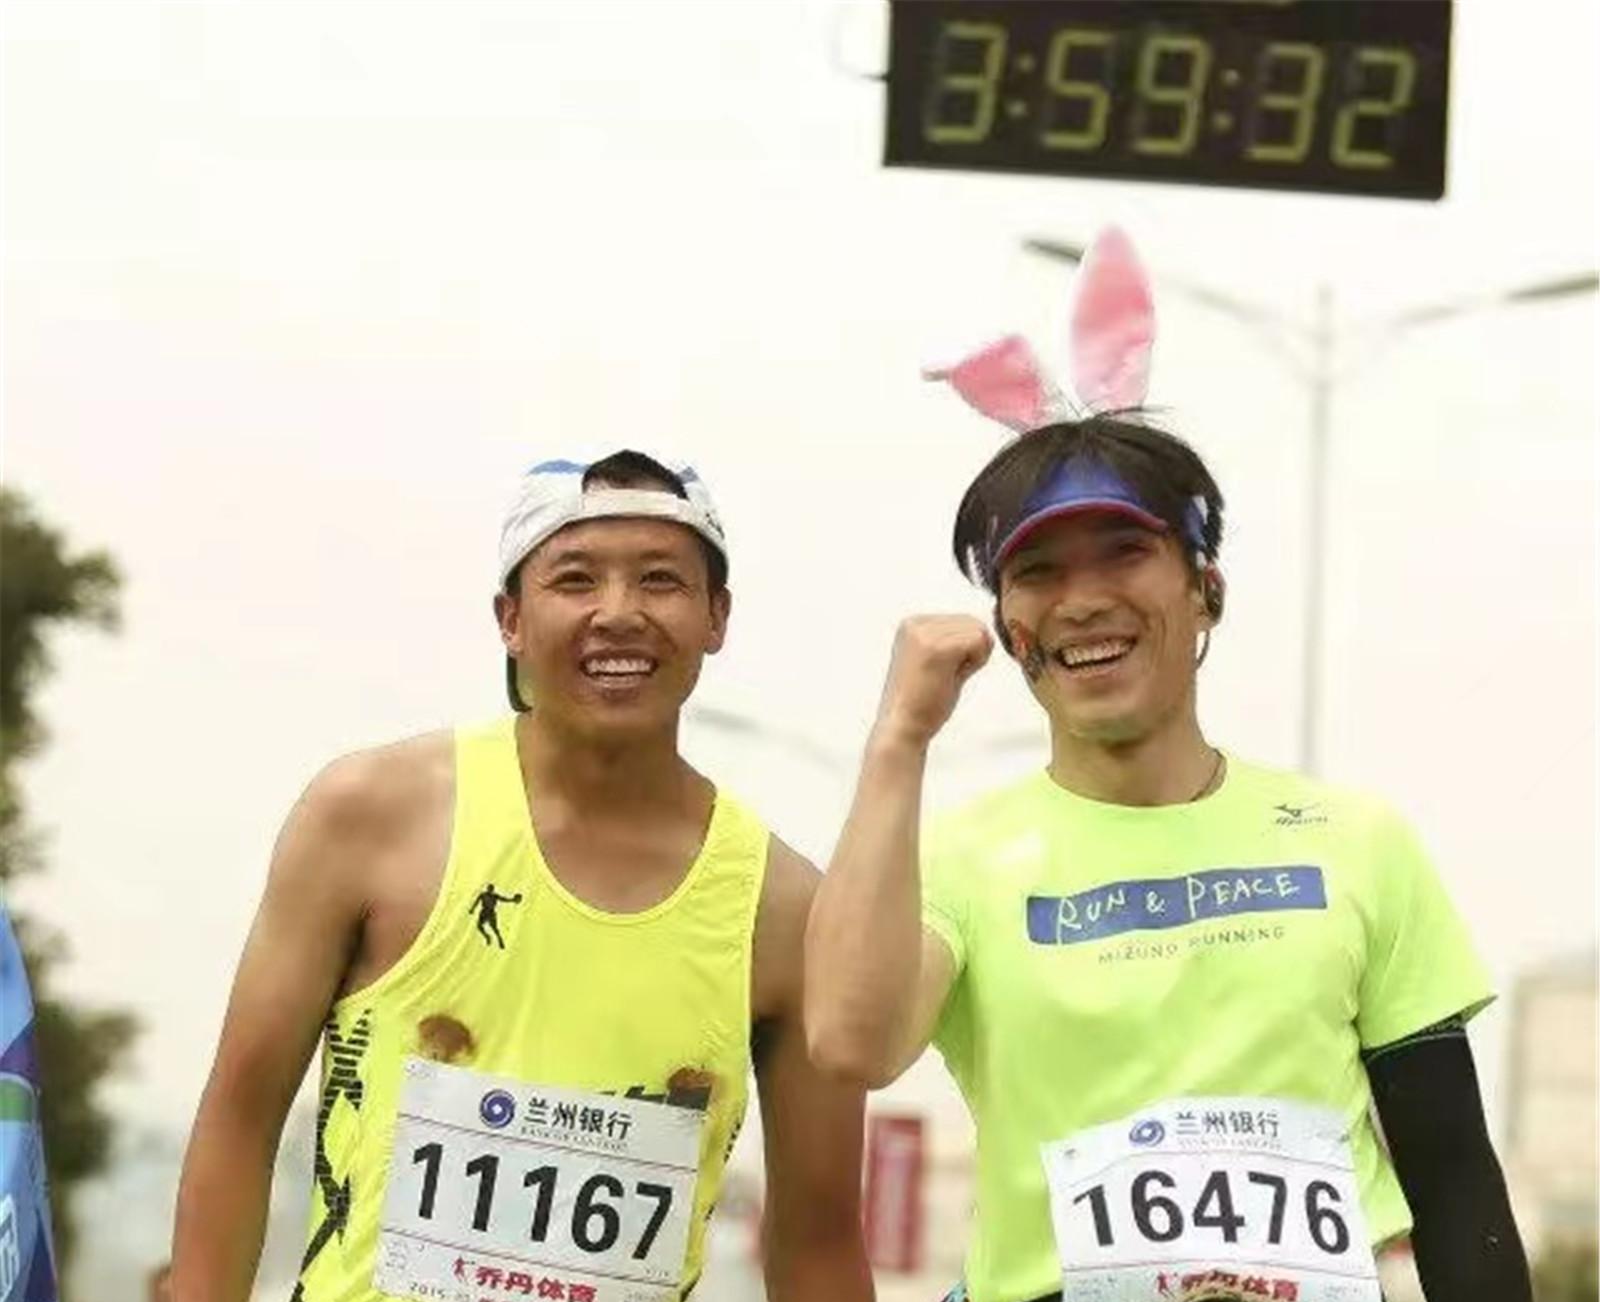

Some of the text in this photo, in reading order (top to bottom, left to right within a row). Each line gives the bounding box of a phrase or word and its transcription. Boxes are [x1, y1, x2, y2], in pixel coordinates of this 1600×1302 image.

[925, 22, 1416, 168] 3:59:32
[1055, 873, 1300, 944] RUN & PEACE
[1189, 926, 1286, 949] RUNNING
[523, 1097, 632, 1141] 兰州银行
[1176, 1110, 1279, 1138] 兰州银行
[413, 1142, 673, 1260] 11167
[1073, 1169, 1350, 1256] 16476
